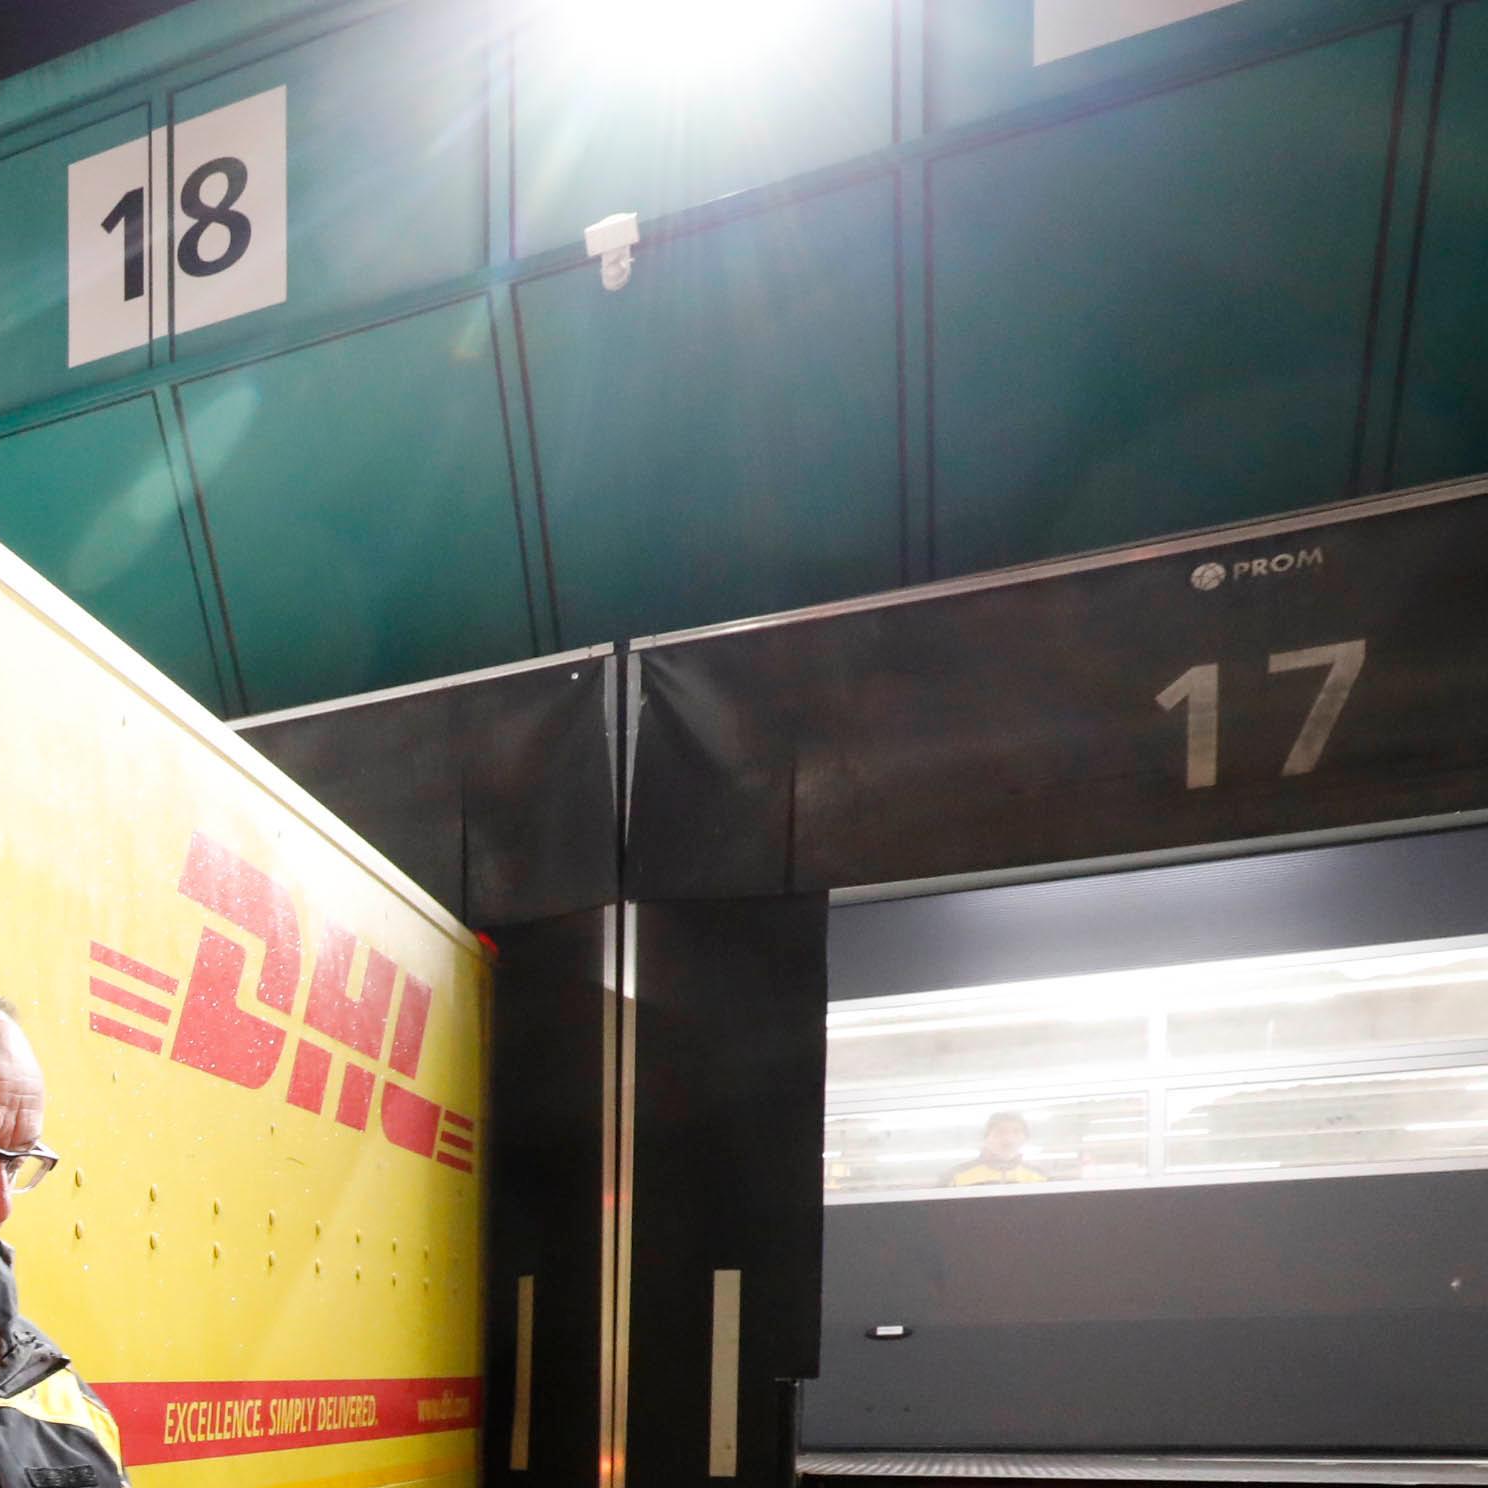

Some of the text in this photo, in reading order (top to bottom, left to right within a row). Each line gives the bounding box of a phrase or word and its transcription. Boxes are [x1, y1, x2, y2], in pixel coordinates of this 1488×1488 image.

[100, 156, 252, 302] 18
[1232, 547, 1324, 580] PROM
[1154, 639, 1366, 789] 17
[169, 831, 442, 1159] DHL
[163, 1394, 379, 1445] EXCELLENCE. SIMPLY DELIVERED.
